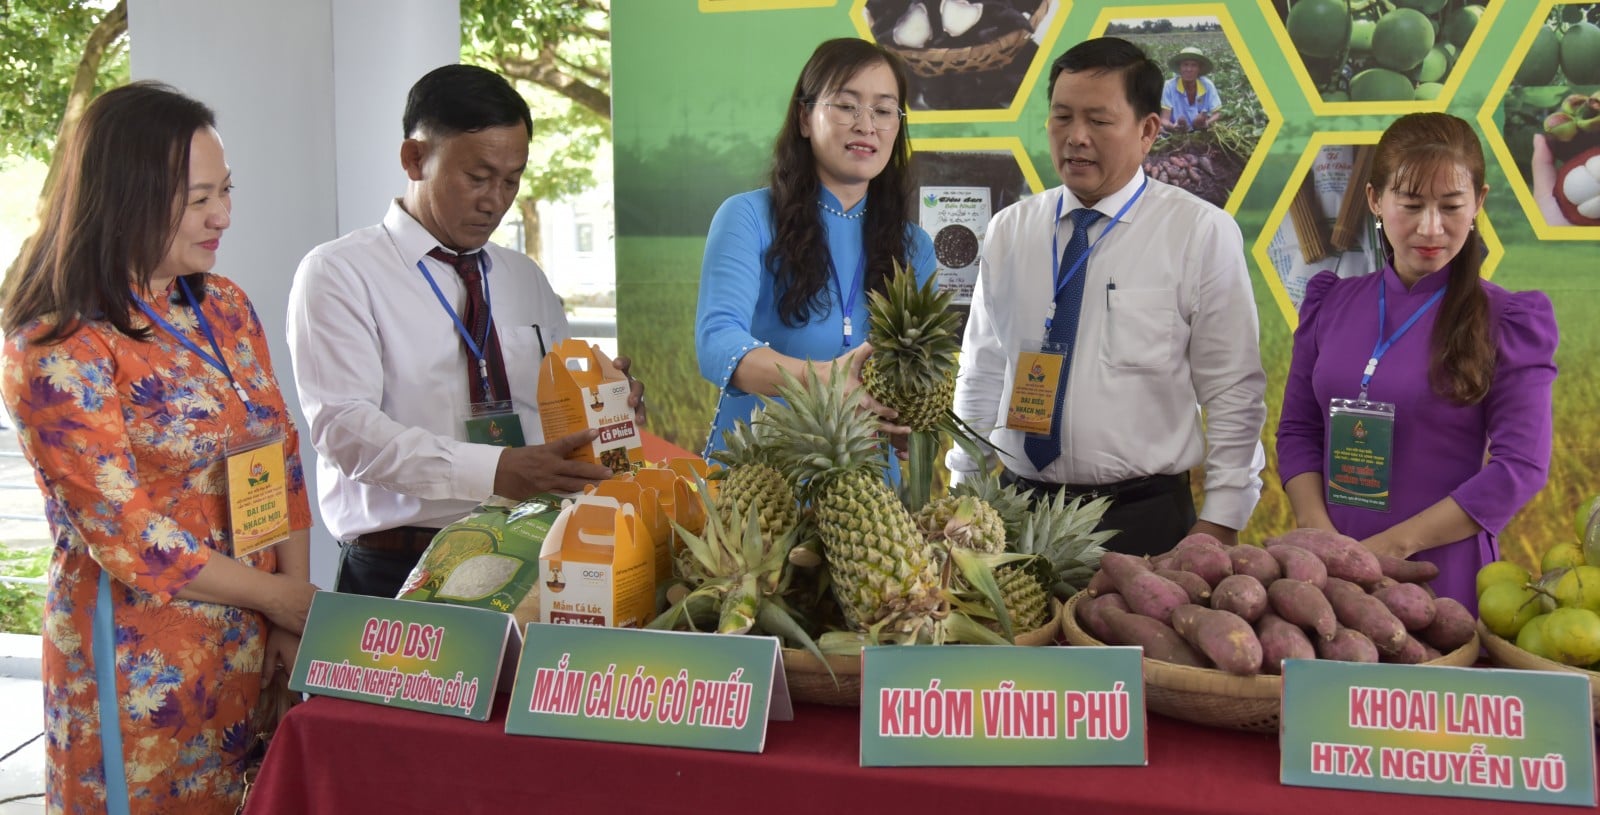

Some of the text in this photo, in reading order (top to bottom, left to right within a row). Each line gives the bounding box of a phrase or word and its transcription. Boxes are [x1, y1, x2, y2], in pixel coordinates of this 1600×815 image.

[601, 424, 633, 441] Cô Phiếu
[583, 570, 604, 578] OCOP
[553, 600, 603, 614] Mắm Cá Lóc
[361, 618, 444, 661] GẠO DS1
[306, 660, 478, 715] HTX NÔNG NGHIỆP ĐƯỜNG GỖ LỘ
[529, 653, 753, 729] MẮM CÁ LÓC CÔ PHIẾU
[879, 678, 1130, 740] KHÓM VĨNH PHÚ
[1349, 686, 1525, 739] KHOAI LANG
[1311, 742, 1566, 792] HTX NGUYỄN VŨ
